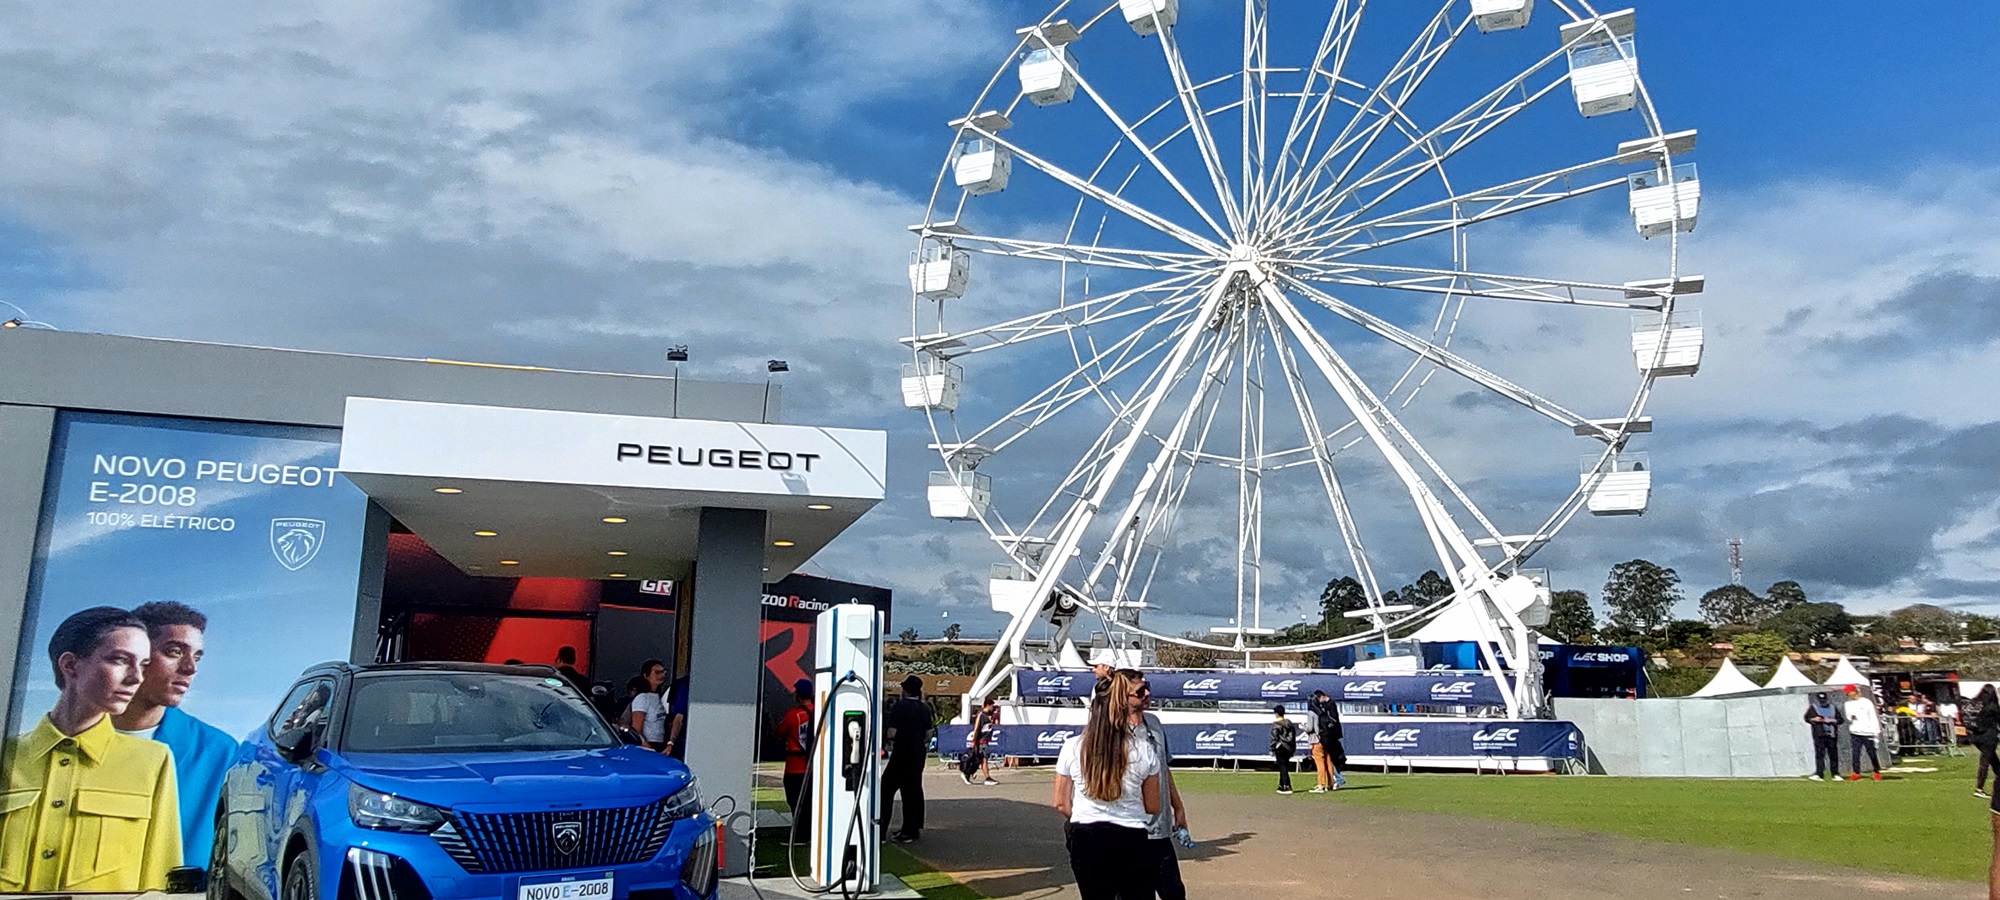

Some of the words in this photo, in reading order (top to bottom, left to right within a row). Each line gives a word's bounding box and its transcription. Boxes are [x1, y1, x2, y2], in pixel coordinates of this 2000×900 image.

[617, 443, 821, 472] PEUGEOT
[93, 454, 186, 479] NOVO
[196, 460, 337, 487] PEUGEOT
[89, 481, 197, 506] E-2008
[86, 511, 136, 527] 100%
[140, 512, 235, 532] ELÉTRICO
[275, 521, 321, 529] PEUGEOT
[788, 596, 830, 611] Racing
[1573, 652, 1597, 661] WEC
[1597, 653, 1629, 662] SHOP
[1037, 676, 1073, 686] WEC
[1183, 678, 1221, 689] WEC
[1261, 680, 1301, 690] WEC
[1343, 680, 1387, 692] WEC
[1430, 681, 1476, 693] WEC
[1195, 729, 1238, 742] WEC
[1373, 728, 1421, 742] WEC
[1472, 728, 1520, 741] WEC
[526, 886, 560, 900] NOVO
[562, 882, 609, 898] E-2008
